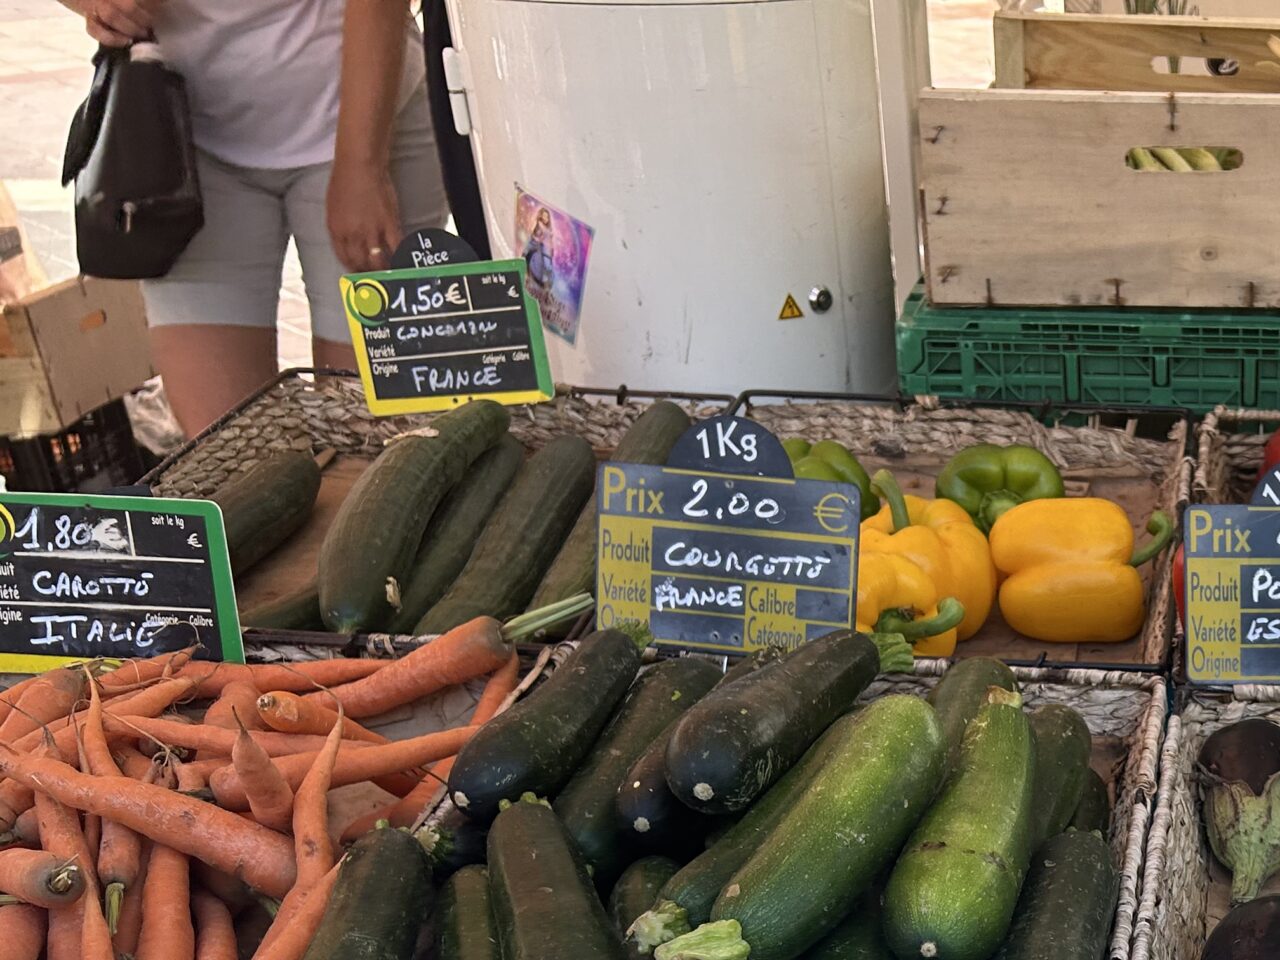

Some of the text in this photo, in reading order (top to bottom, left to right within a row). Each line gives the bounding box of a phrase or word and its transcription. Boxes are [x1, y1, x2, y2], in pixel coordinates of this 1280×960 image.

[417, 232, 432, 250] la
[411, 250, 449, 268] Pièce
[365, 327, 390, 340] Produit
[368, 344, 396, 358] Variété
[373, 363, 399, 378] Origine
[412, 365, 502, 392] FRANCE
[603, 466, 665, 514] Prix
[151, 515, 185, 529] soit le kg
[812, 492, 850, 533] €
[187, 533, 203, 548] €
[1190, 509, 1252, 553] Prix
[602, 529, 650, 563] Produit
[0, 584, 20, 600] iété
[602, 573, 647, 603] Variété
[1190, 571, 1239, 603] Produit
[748, 586, 796, 616] Calibre
[0, 606, 23, 625] igine
[189, 614, 213, 627] Calibre
[1191, 615, 1237, 642] Variété
[747, 616, 802, 650] Catégorie
[1191, 646, 1239, 677] Origine
